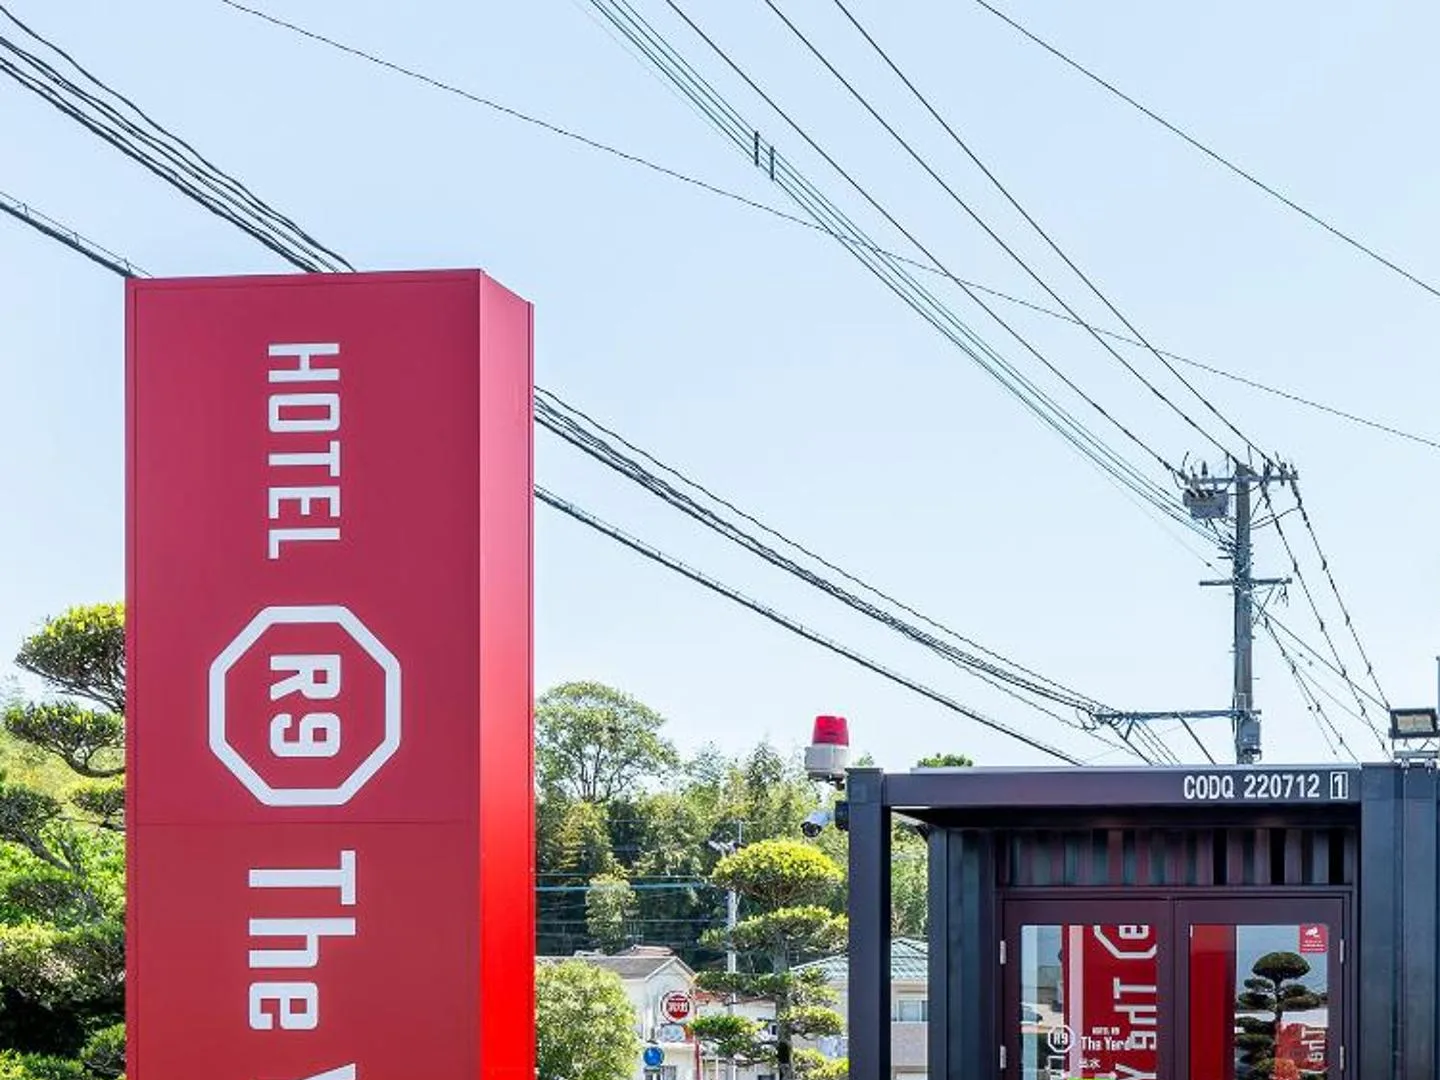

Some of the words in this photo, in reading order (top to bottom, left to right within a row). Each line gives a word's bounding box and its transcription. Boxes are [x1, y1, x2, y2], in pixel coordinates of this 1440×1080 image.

[268, 343, 341, 559] HOTEL
[270, 653, 342, 758] R9
[1184, 775, 1235, 799] CODQ
[1243, 773, 1320, 798] 220712
[1333, 774, 1345, 798] 1
[249, 849, 356, 1030] The
